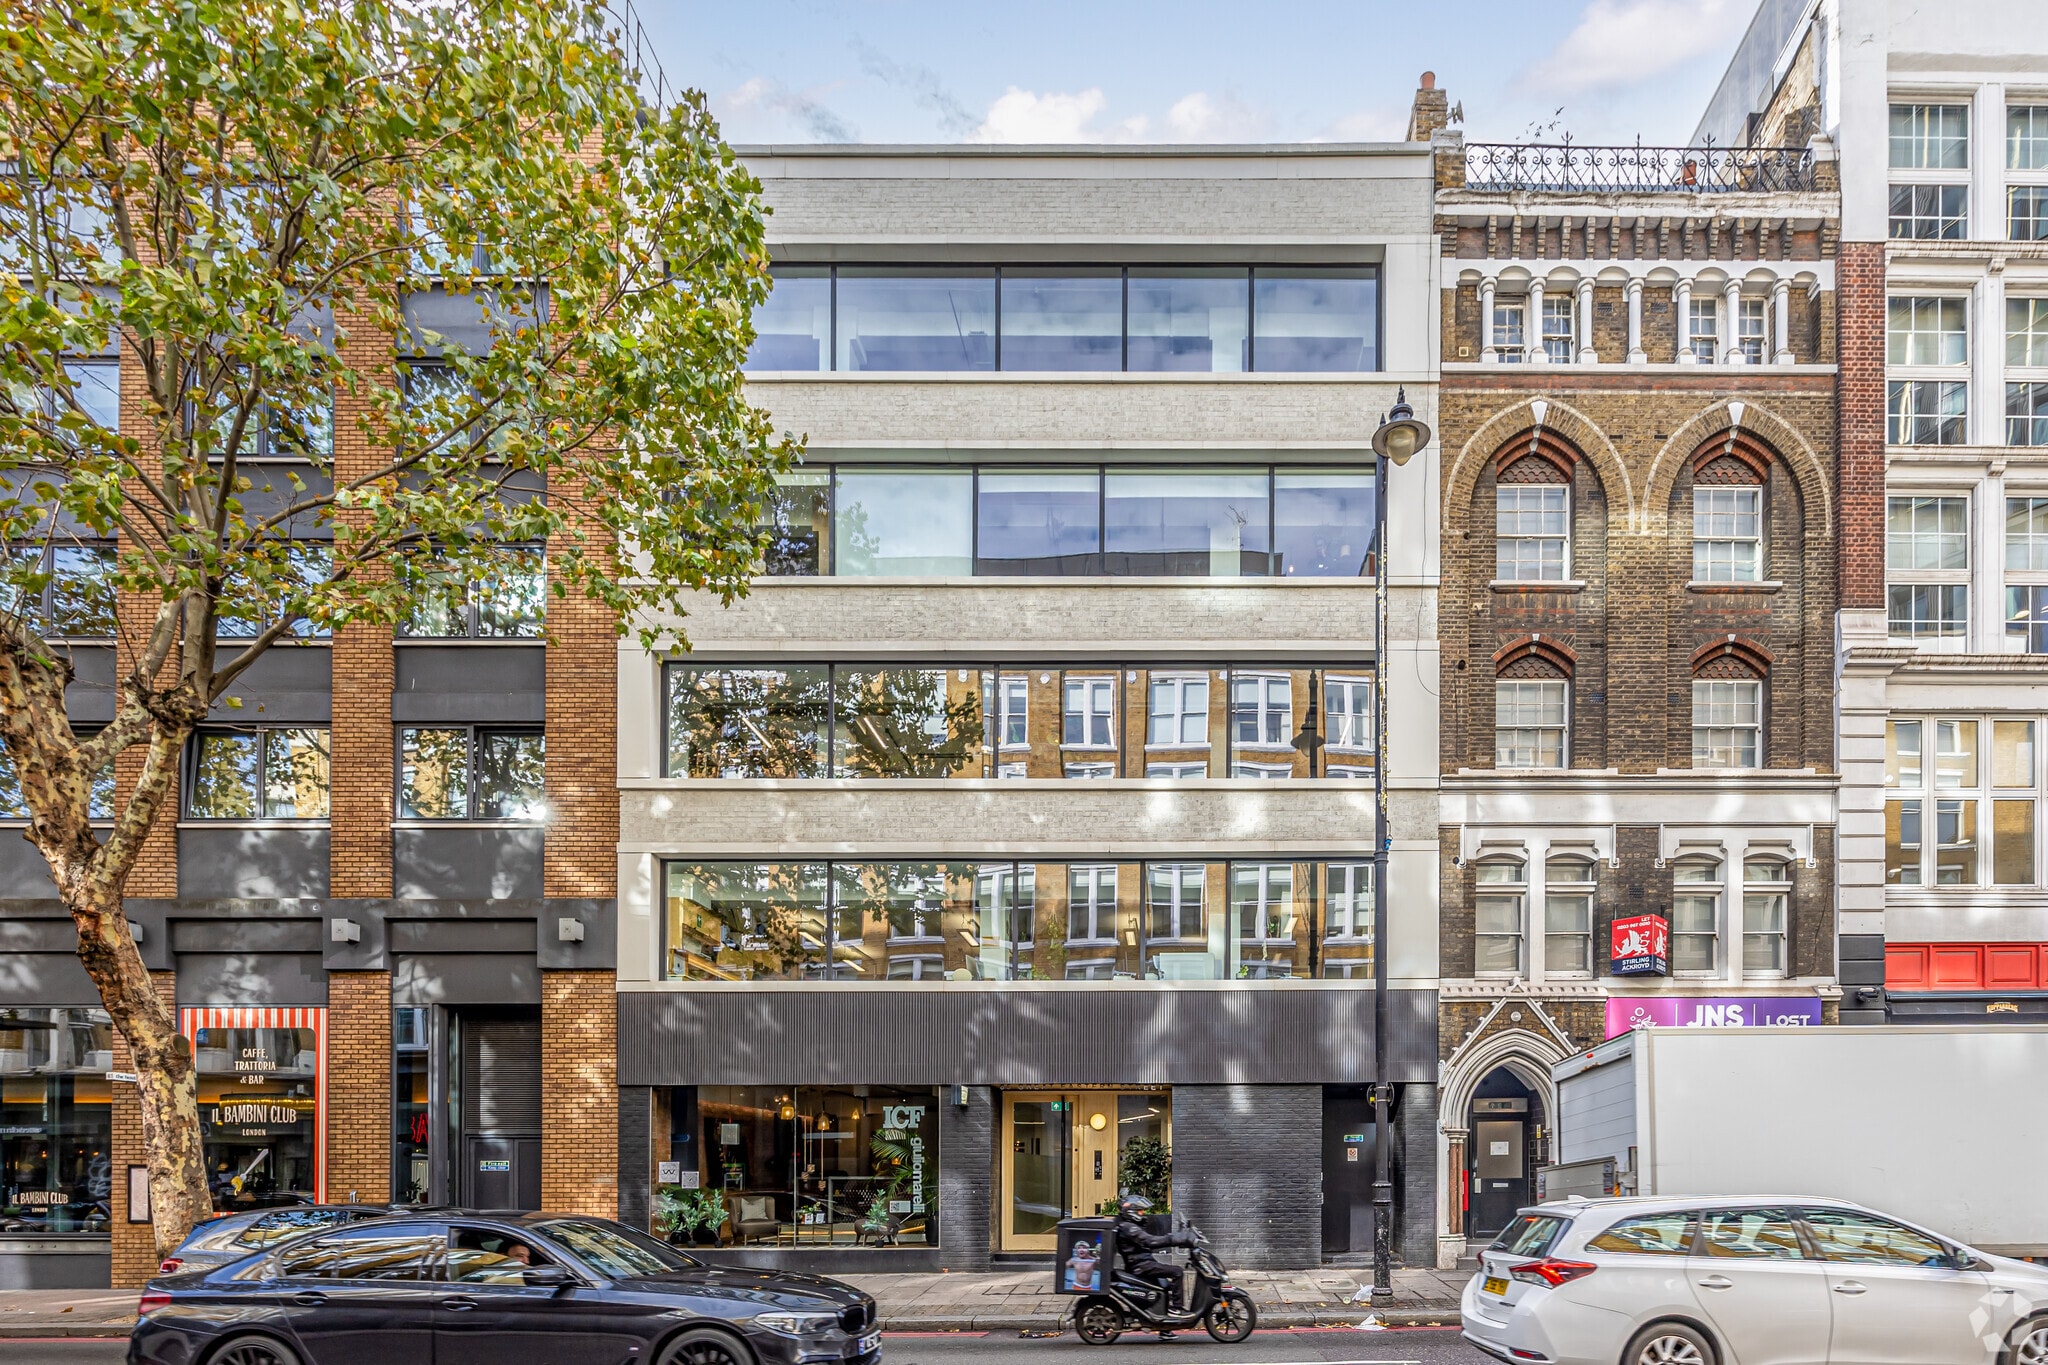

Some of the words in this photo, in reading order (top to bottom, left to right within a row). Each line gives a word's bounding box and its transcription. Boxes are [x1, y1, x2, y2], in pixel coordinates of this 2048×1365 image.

[1621, 962, 1650, 972] ACKROYD
[1622, 956, 1650, 966] STIRLING
[1686, 1004, 1744, 1027] JNS
[1766, 1014, 1811, 1027] LOST
[242, 1048, 268, 1060] CAFFE,
[234, 1061, 276, 1071] TRATTORIA
[240, 1076, 247, 1084] &
[248, 1075, 264, 1084] BAR
[211, 1107, 222, 1123] IL
[224, 1104, 267, 1123] BAMBINI
[270, 1105, 297, 1123] CLUB
[882, 1105, 925, 1129] ICF
[242, 1128, 266, 1136] LONDON
[12, 1193, 19, 1204] IL
[20, 1191, 49, 1204] BAMBINI
[50, 1191, 68, 1204] CLUB
